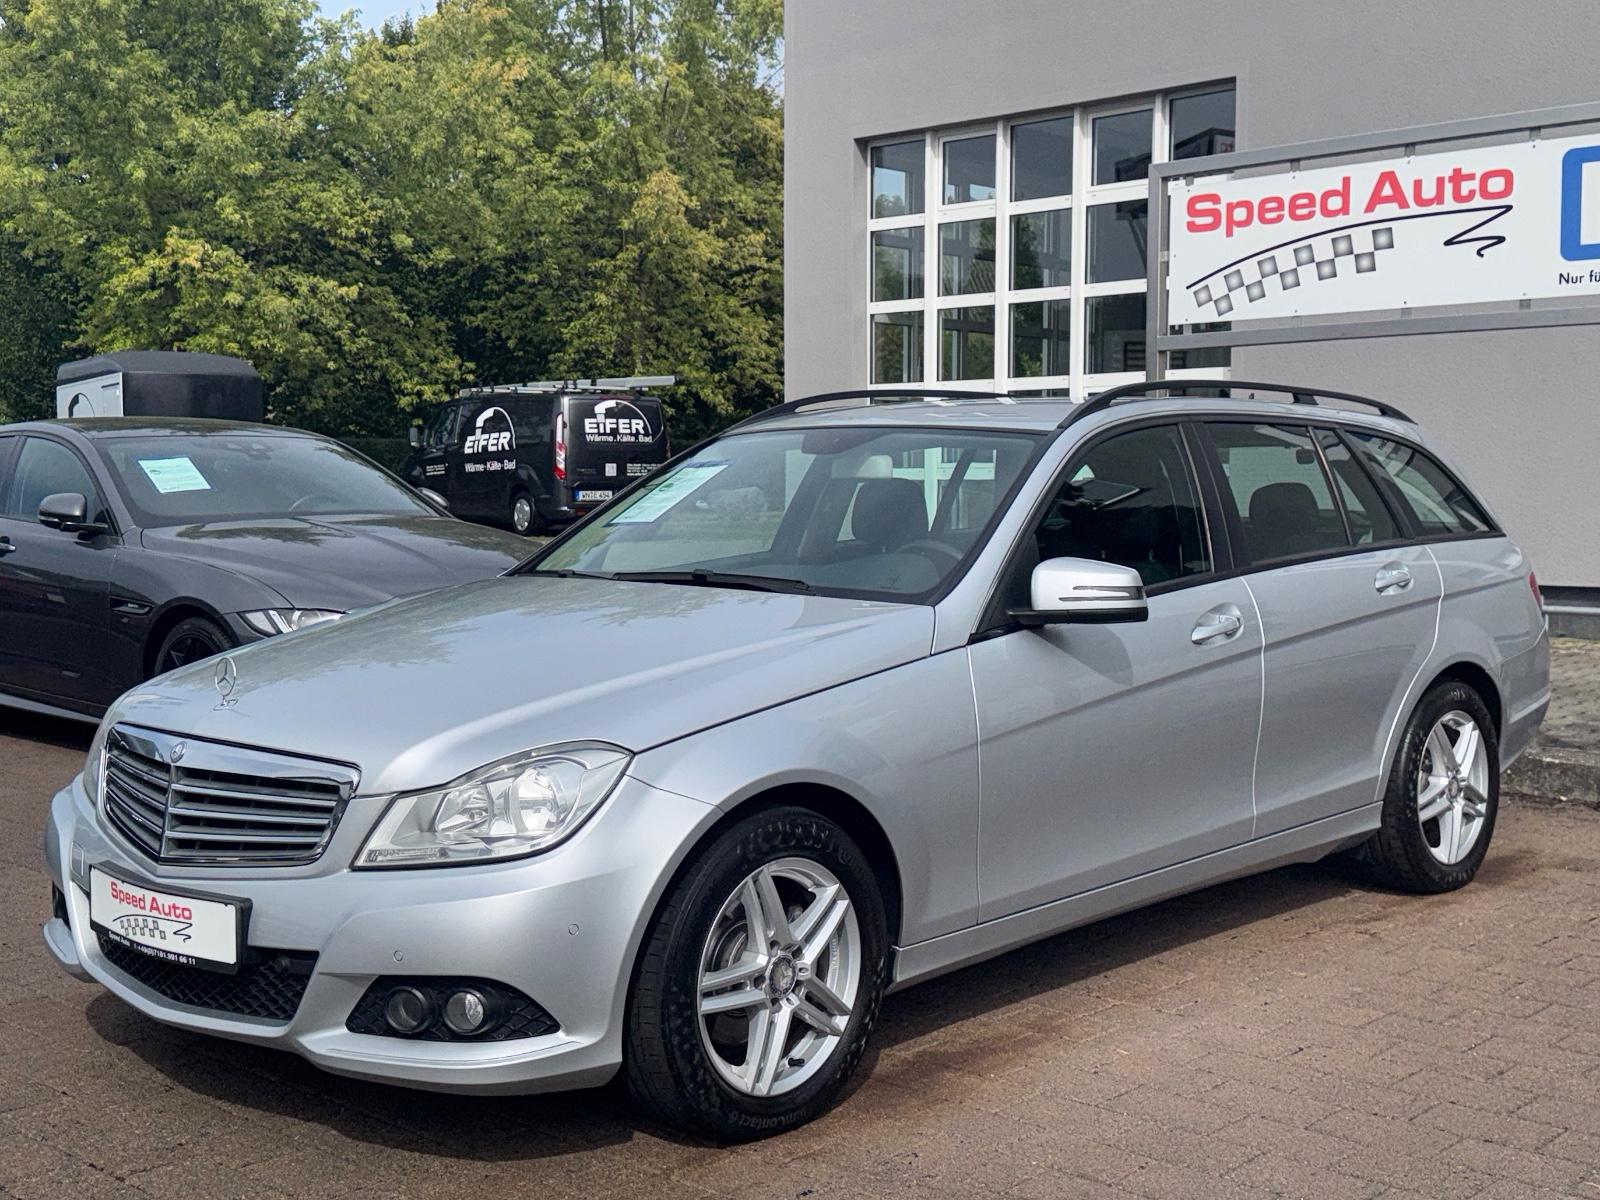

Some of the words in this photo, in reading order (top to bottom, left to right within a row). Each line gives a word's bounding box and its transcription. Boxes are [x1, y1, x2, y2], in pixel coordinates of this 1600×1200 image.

[1186, 176, 1352, 238] Speed
[1364, 166, 1515, 214] Auto
[1559, 272, 1585, 285] Nur
[503, 459, 516, 470] Bad
[110, 880, 146, 911] Speed
[150, 897, 192, 921] Auto
